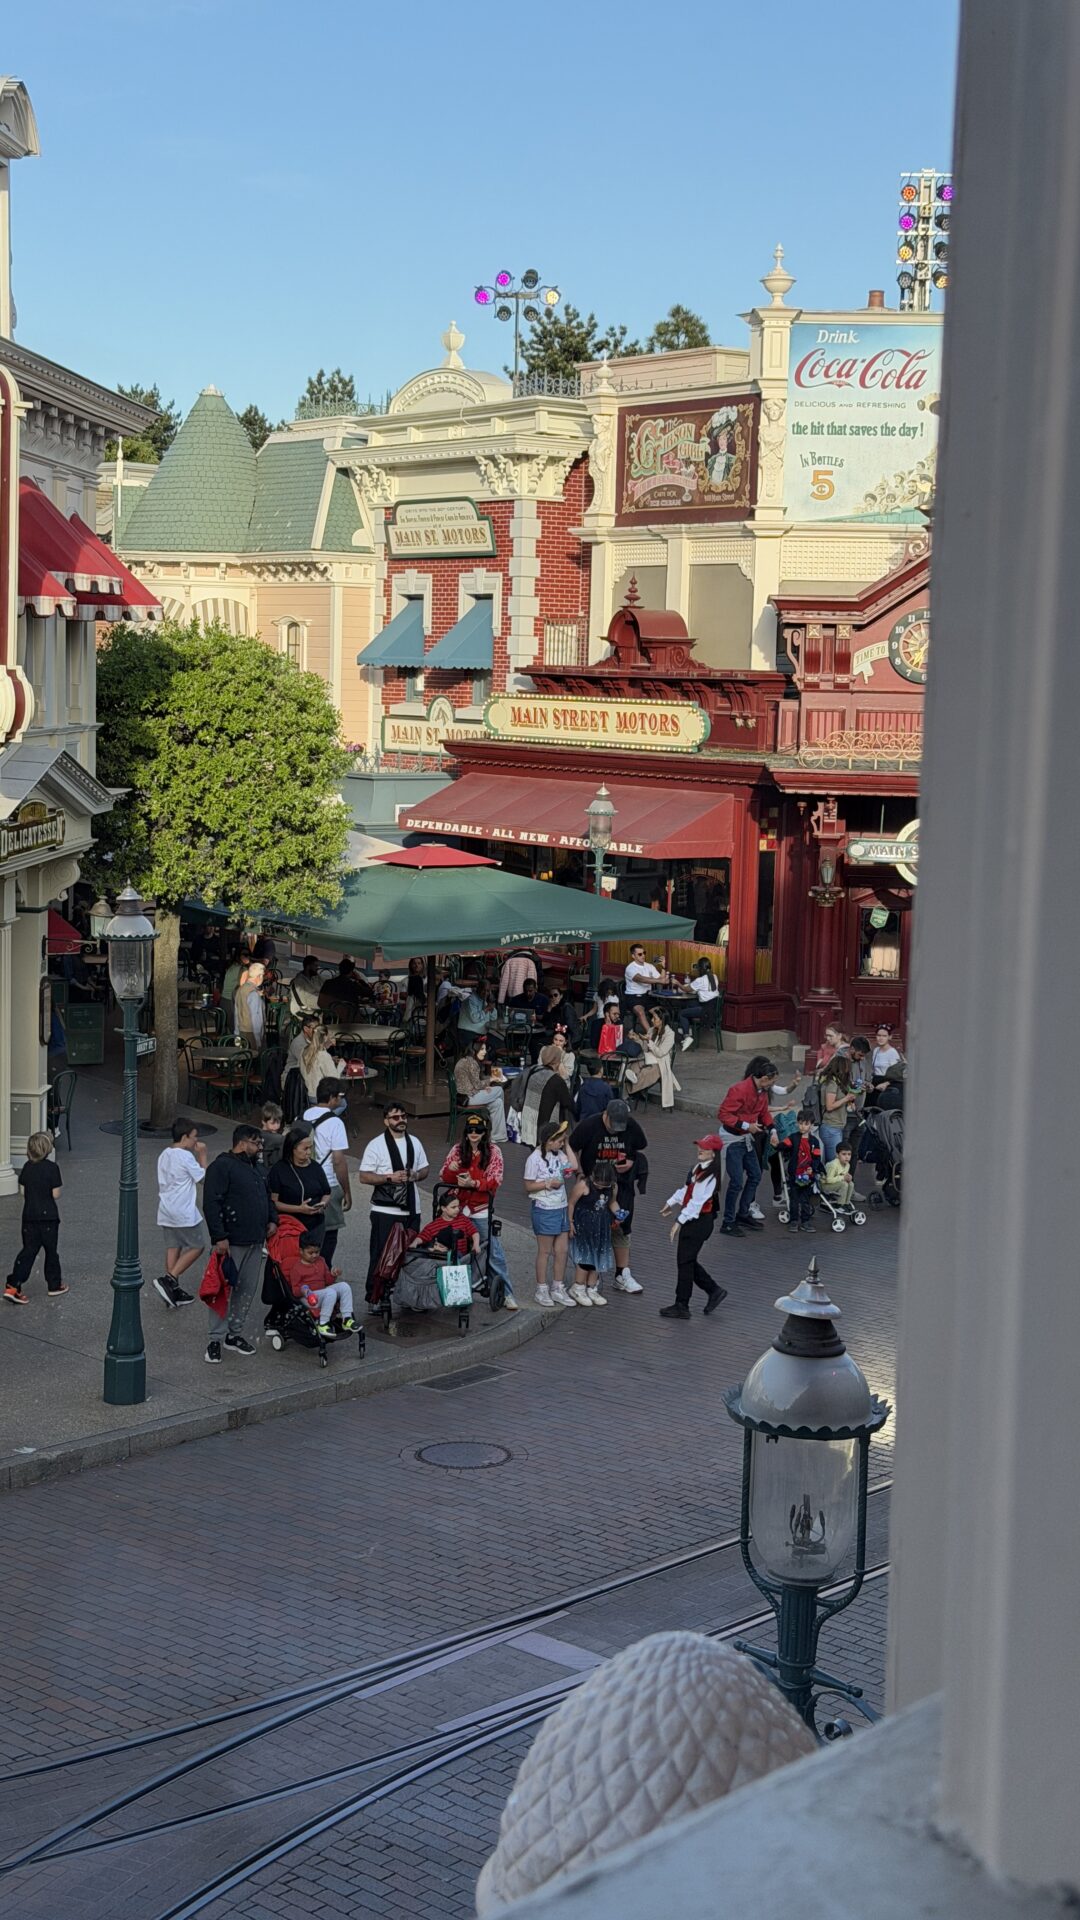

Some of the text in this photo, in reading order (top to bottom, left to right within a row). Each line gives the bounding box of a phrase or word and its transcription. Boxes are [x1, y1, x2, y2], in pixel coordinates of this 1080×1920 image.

[816, 330, 860, 344] Drink
[794, 348, 934, 390] Coca-Cola
[791, 421, 808, 435] the
[810, 421, 825, 436] hit
[826, 422, 847, 436] that
[849, 424, 878, 437] saves
[880, 422, 897, 437] the
[395, 530, 422, 546] MAIN
[442, 527, 487, 545] MOTORS
[856, 646, 886, 664] TIME TO
[510, 706, 680, 736] MAIN STREET MOTORS
[391, 725, 422, 744] MAIN
[1, 816, 63, 856] DELICATESSEN
[406, 819, 643, 854] DEPENDABLE ALL NEW AFFOABLE
[868, 845, 906, 858] MAIN
[533, 935, 559, 944] DELI
